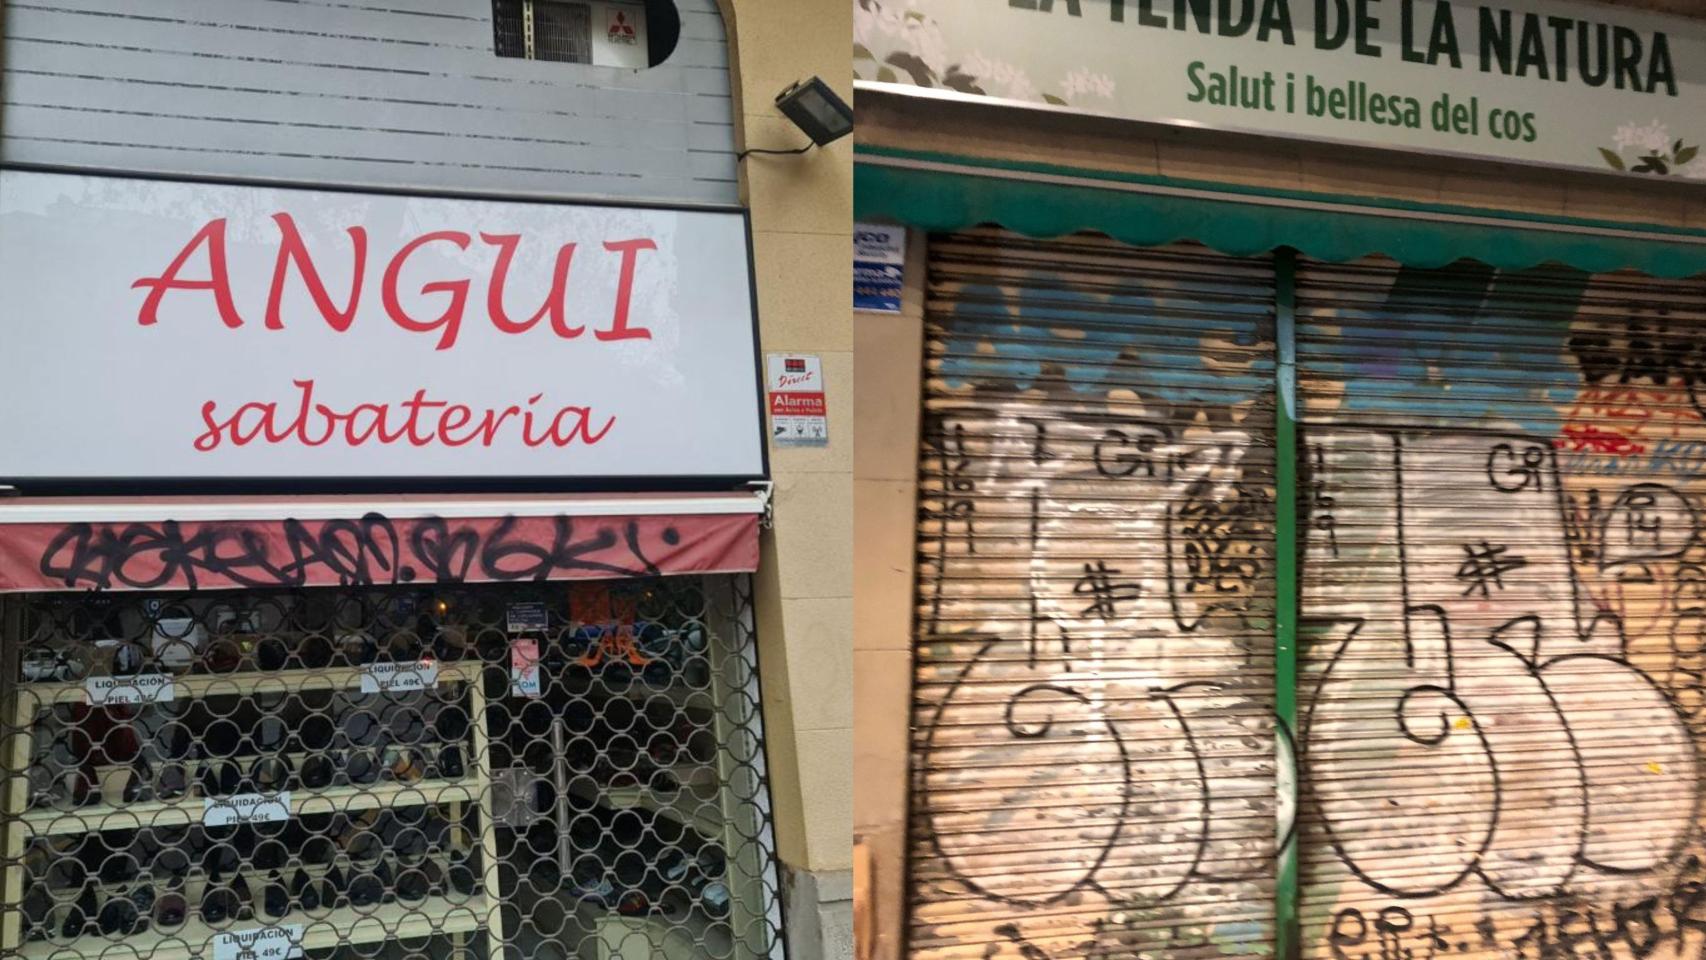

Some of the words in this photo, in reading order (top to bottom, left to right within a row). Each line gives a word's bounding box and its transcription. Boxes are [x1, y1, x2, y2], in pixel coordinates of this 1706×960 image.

[1314, 0, 1382, 58] DE
[1401, 0, 1463, 70] LA
[1478, 6, 1679, 97] NATURA
[1187, 60, 1276, 112] Salut
[1285, 72, 1295, 114] i
[1306, 74, 1421, 129] bellesa
[1431, 93, 1479, 136] del
[1488, 107, 1538, 143] cos
[131, 211, 659, 351] ANGUI
[774, 394, 823, 407] Alarma
